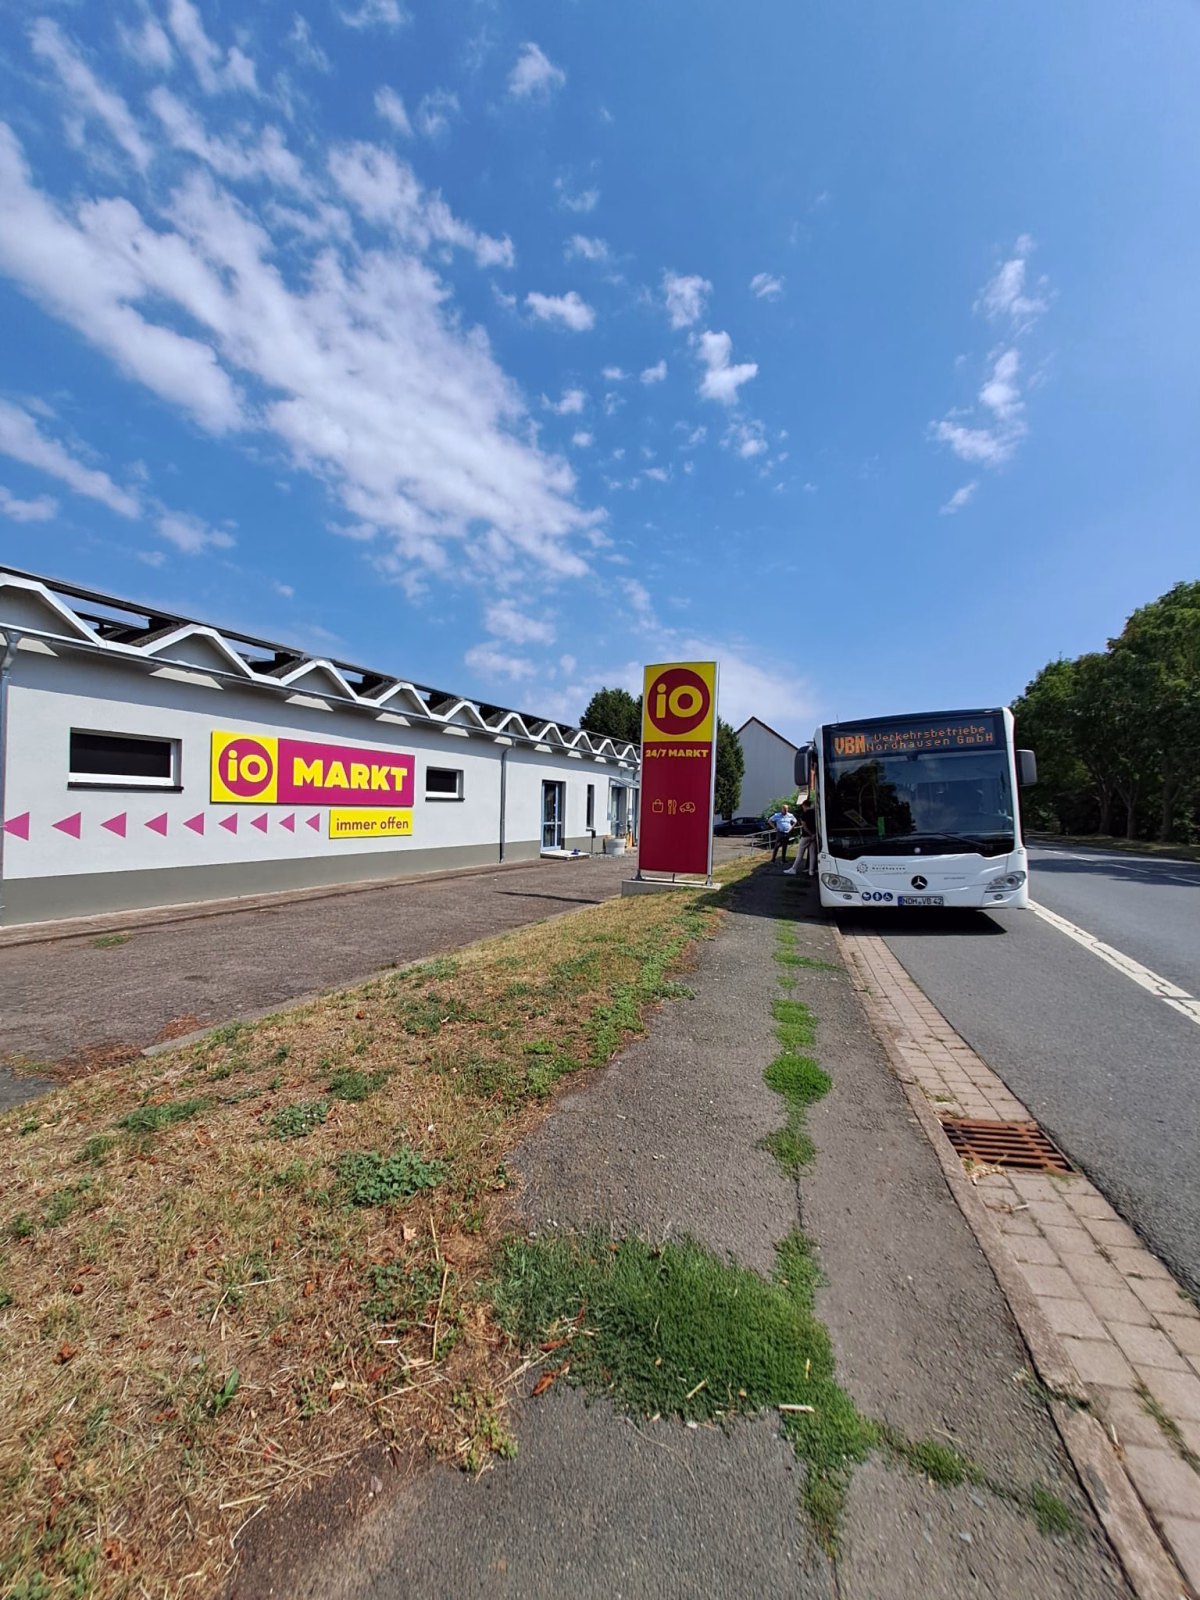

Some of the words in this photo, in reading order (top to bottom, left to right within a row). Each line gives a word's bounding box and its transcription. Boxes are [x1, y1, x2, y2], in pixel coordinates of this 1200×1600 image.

[656, 683, 703, 719] iO
[865, 738, 950, 751] Nordhausen
[957, 732, 993, 744] GmbH
[873, 725, 986, 743] Verkehrsbetriebe
[645, 748, 667, 758] 24/7
[668, 749, 709, 758] MARKT
[834, 735, 866, 755] VBN
[227, 749, 268, 783] iO
[293, 757, 408, 792] MARKT
[336, 818, 377, 831] immer
[380, 816, 409, 830] offen
